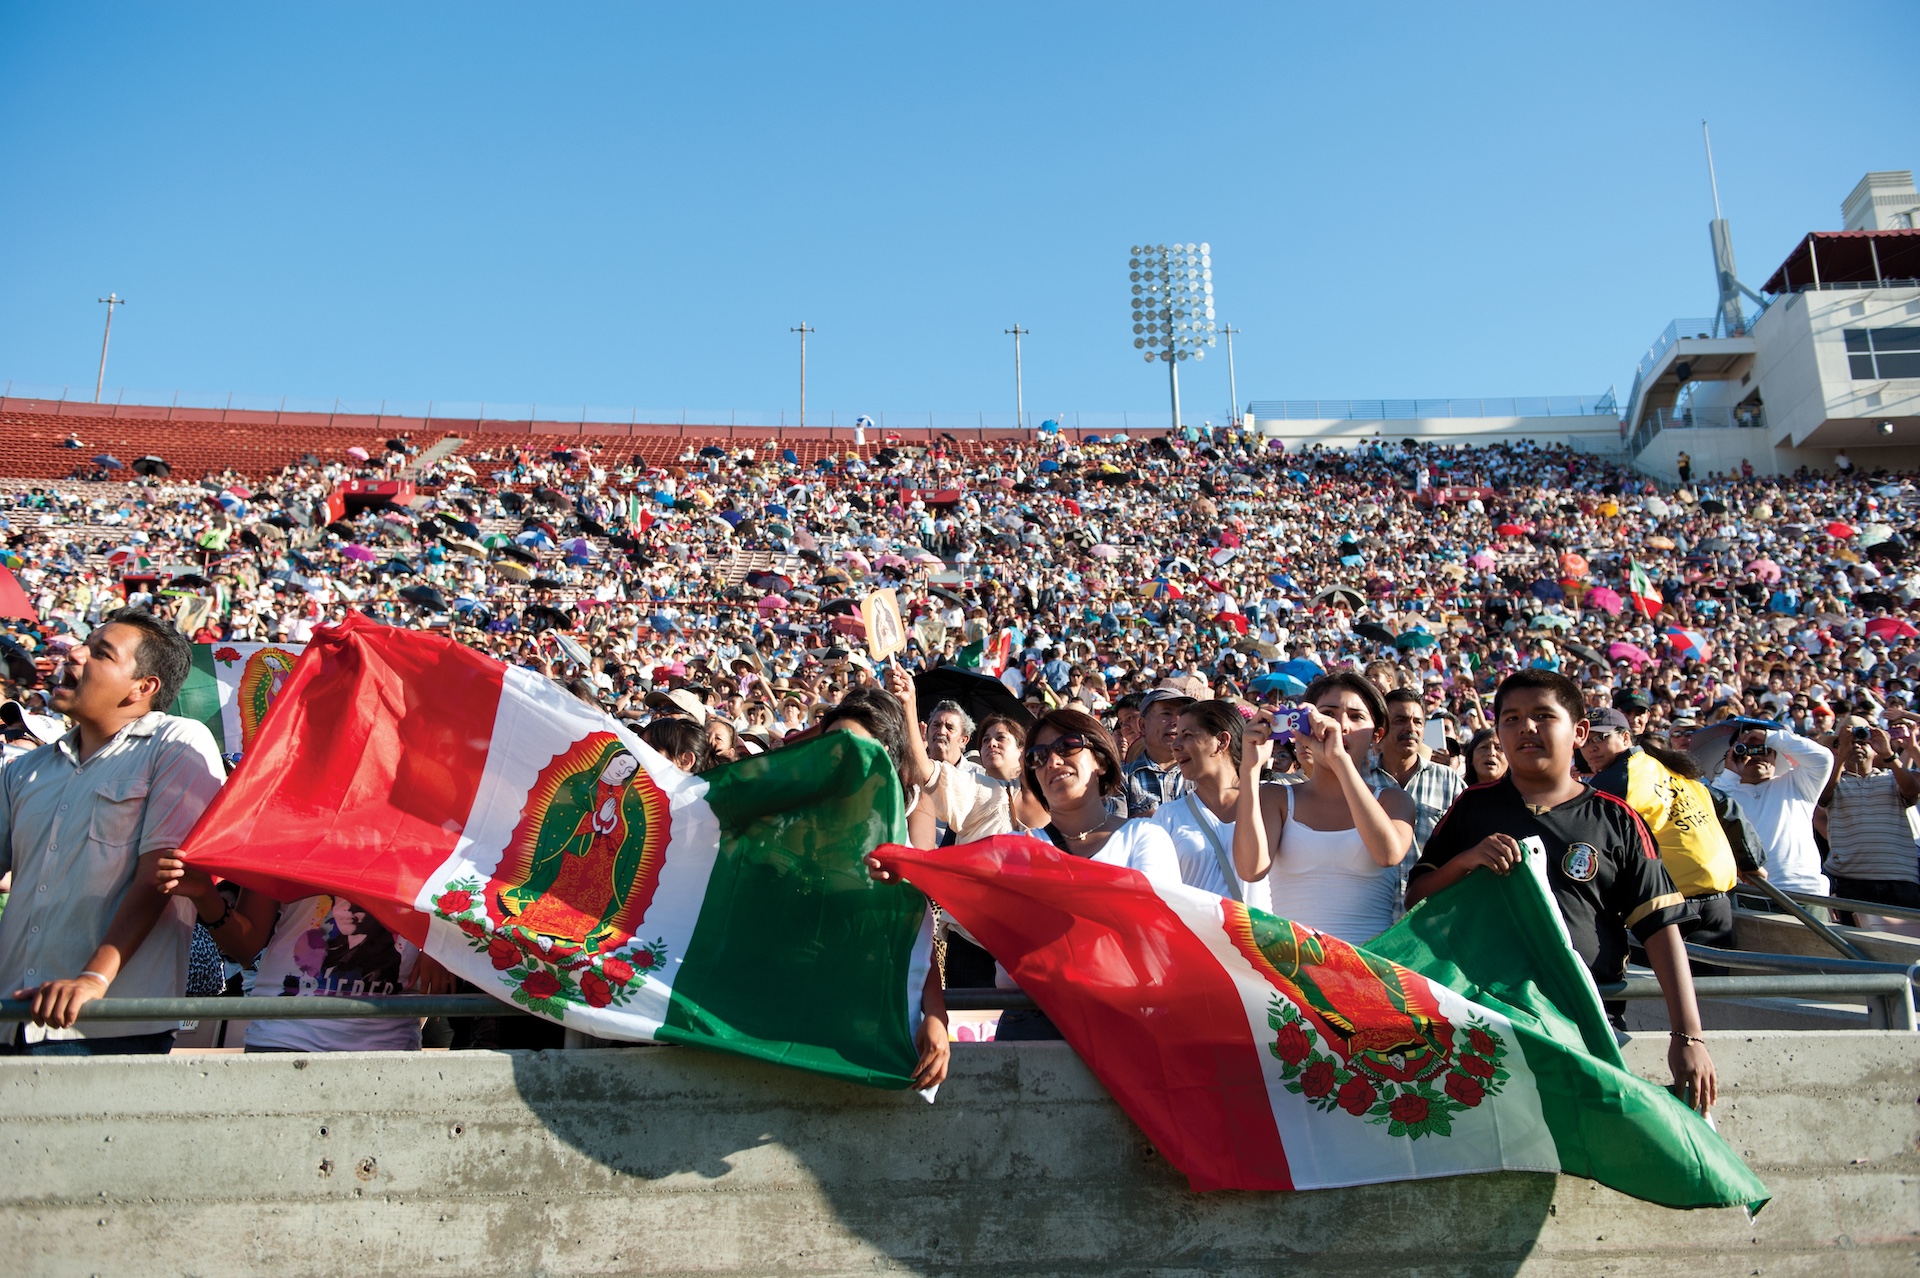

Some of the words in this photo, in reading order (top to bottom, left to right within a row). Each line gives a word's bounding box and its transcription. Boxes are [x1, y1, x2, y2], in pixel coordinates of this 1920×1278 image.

[351, 480, 359, 491] 3
[1445, 487, 1453, 497] 5
[1674, 810, 1712, 831] STAF
